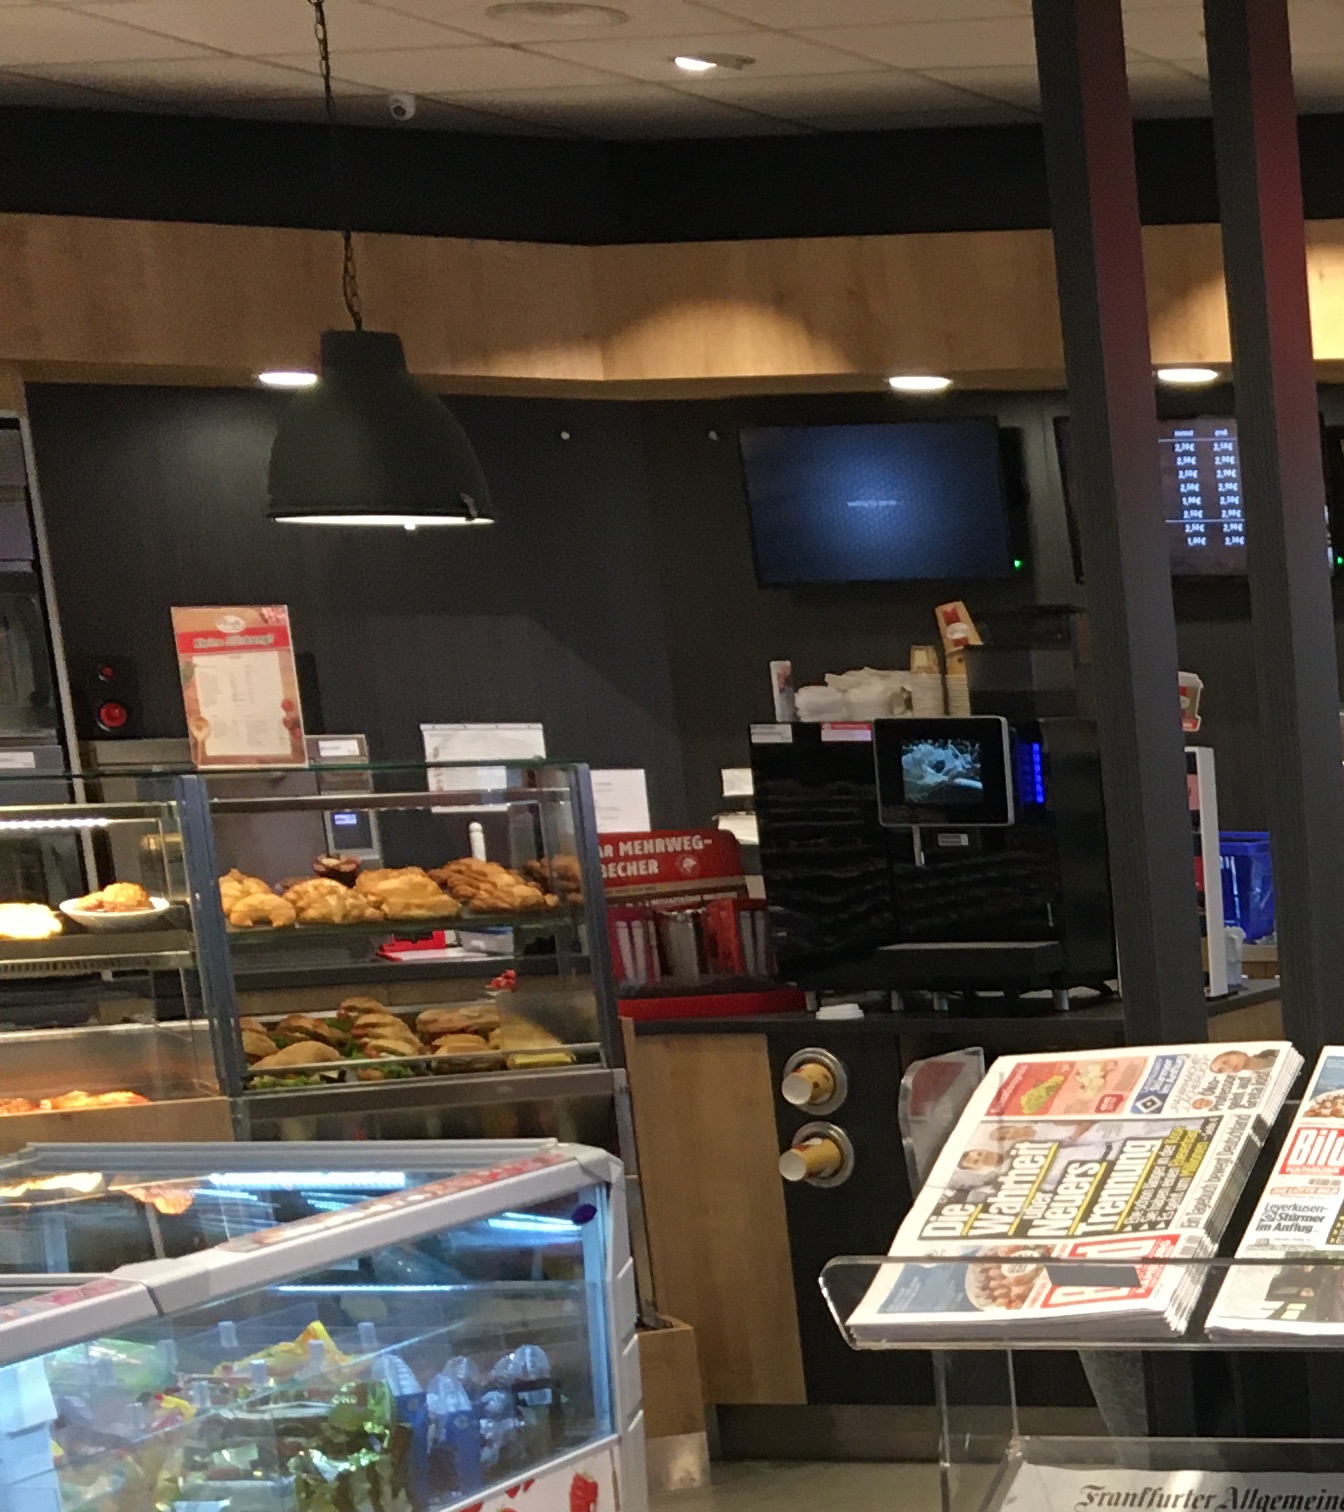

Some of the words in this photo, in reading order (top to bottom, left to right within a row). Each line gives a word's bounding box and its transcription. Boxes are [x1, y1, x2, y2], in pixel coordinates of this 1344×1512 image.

[619, 835, 712, 857] MEHRWEG-
[967, 1139, 1055, 1235] Wahrheit
[1026, 1161, 1102, 1235] Neuers
[1076, 1135, 1165, 1232] Trennung
[920, 1202, 978, 1237] Die
[1272, 1223, 1313, 1234] Anflug
[1278, 1212, 1325, 1222] Stürmer
[1074, 1484, 1215, 1512] Frankfurter
